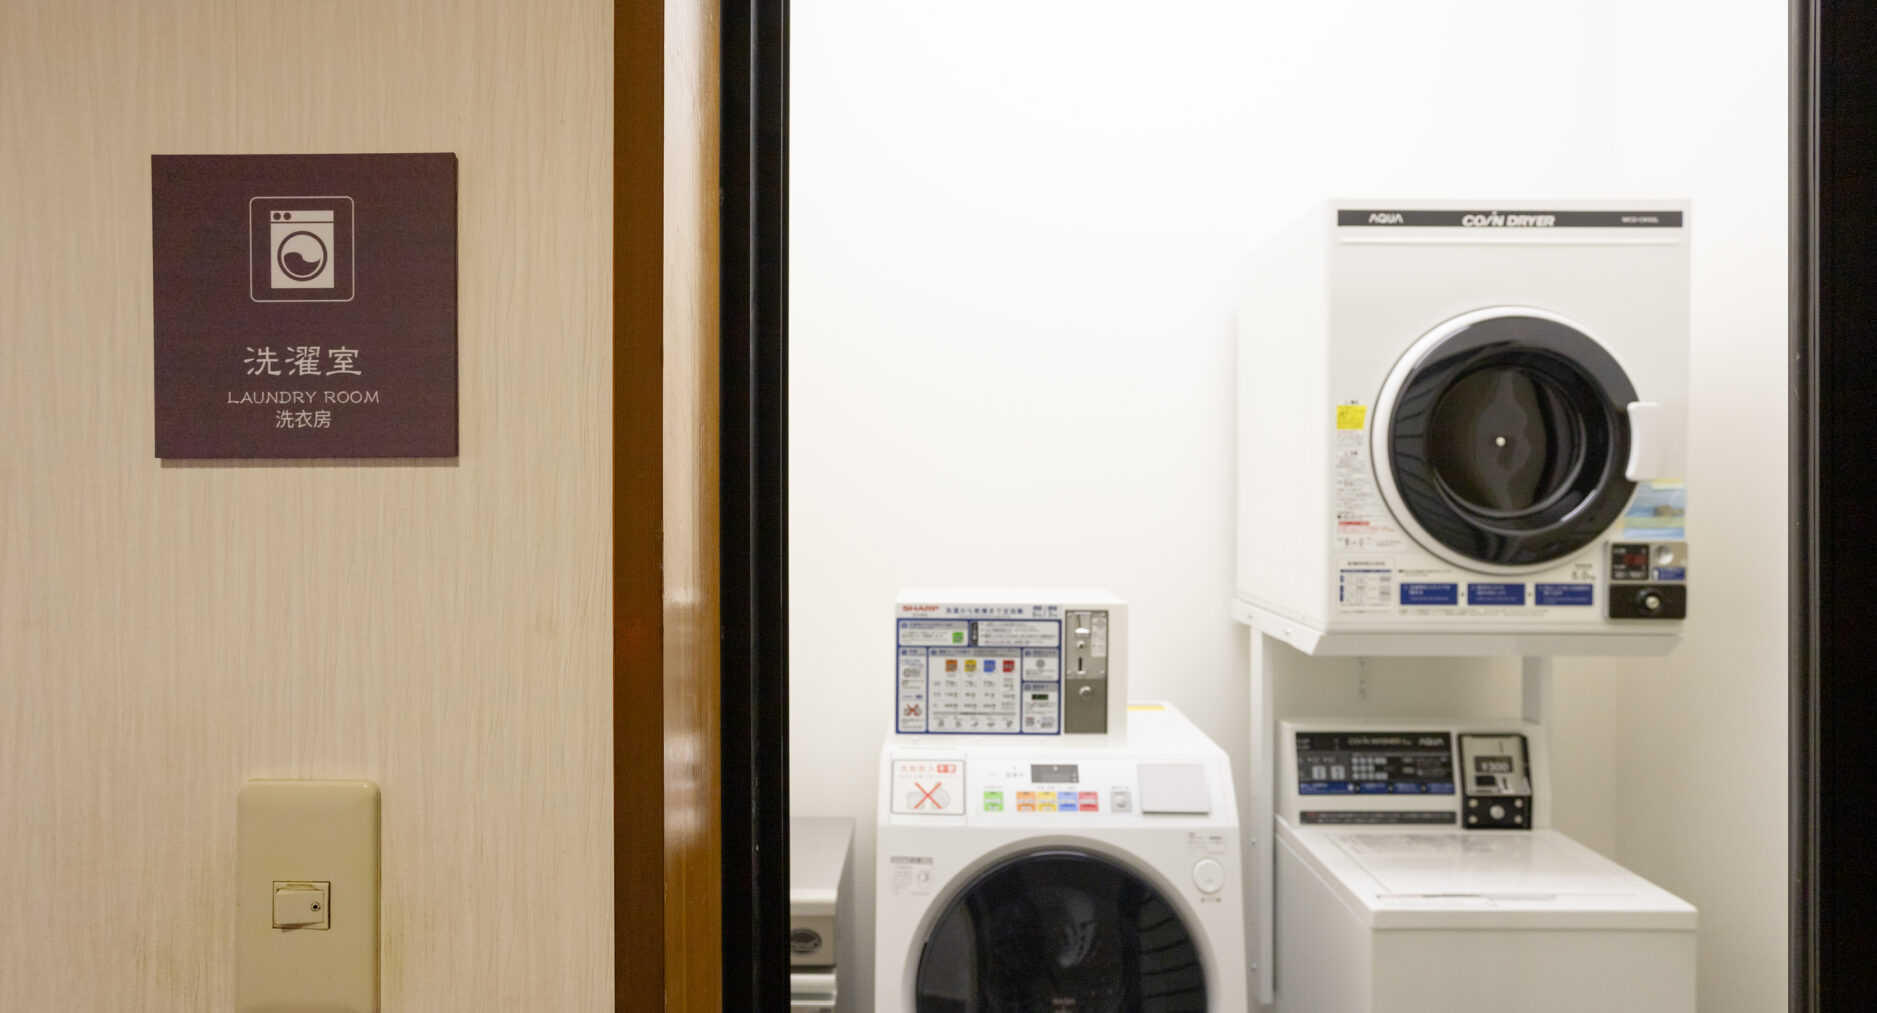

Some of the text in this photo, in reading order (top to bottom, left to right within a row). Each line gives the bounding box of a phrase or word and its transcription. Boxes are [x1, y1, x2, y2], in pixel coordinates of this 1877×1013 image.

[1368, 213, 1404, 225] AQUA
[1461, 211, 1556, 227] COIN DRYER
[243, 345, 362, 376] 洗濯室
[227, 390, 380, 405] LAUNDRY ROOM
[275, 409, 332, 429] 洗衣房
[902, 604, 940, 613] SHARP
